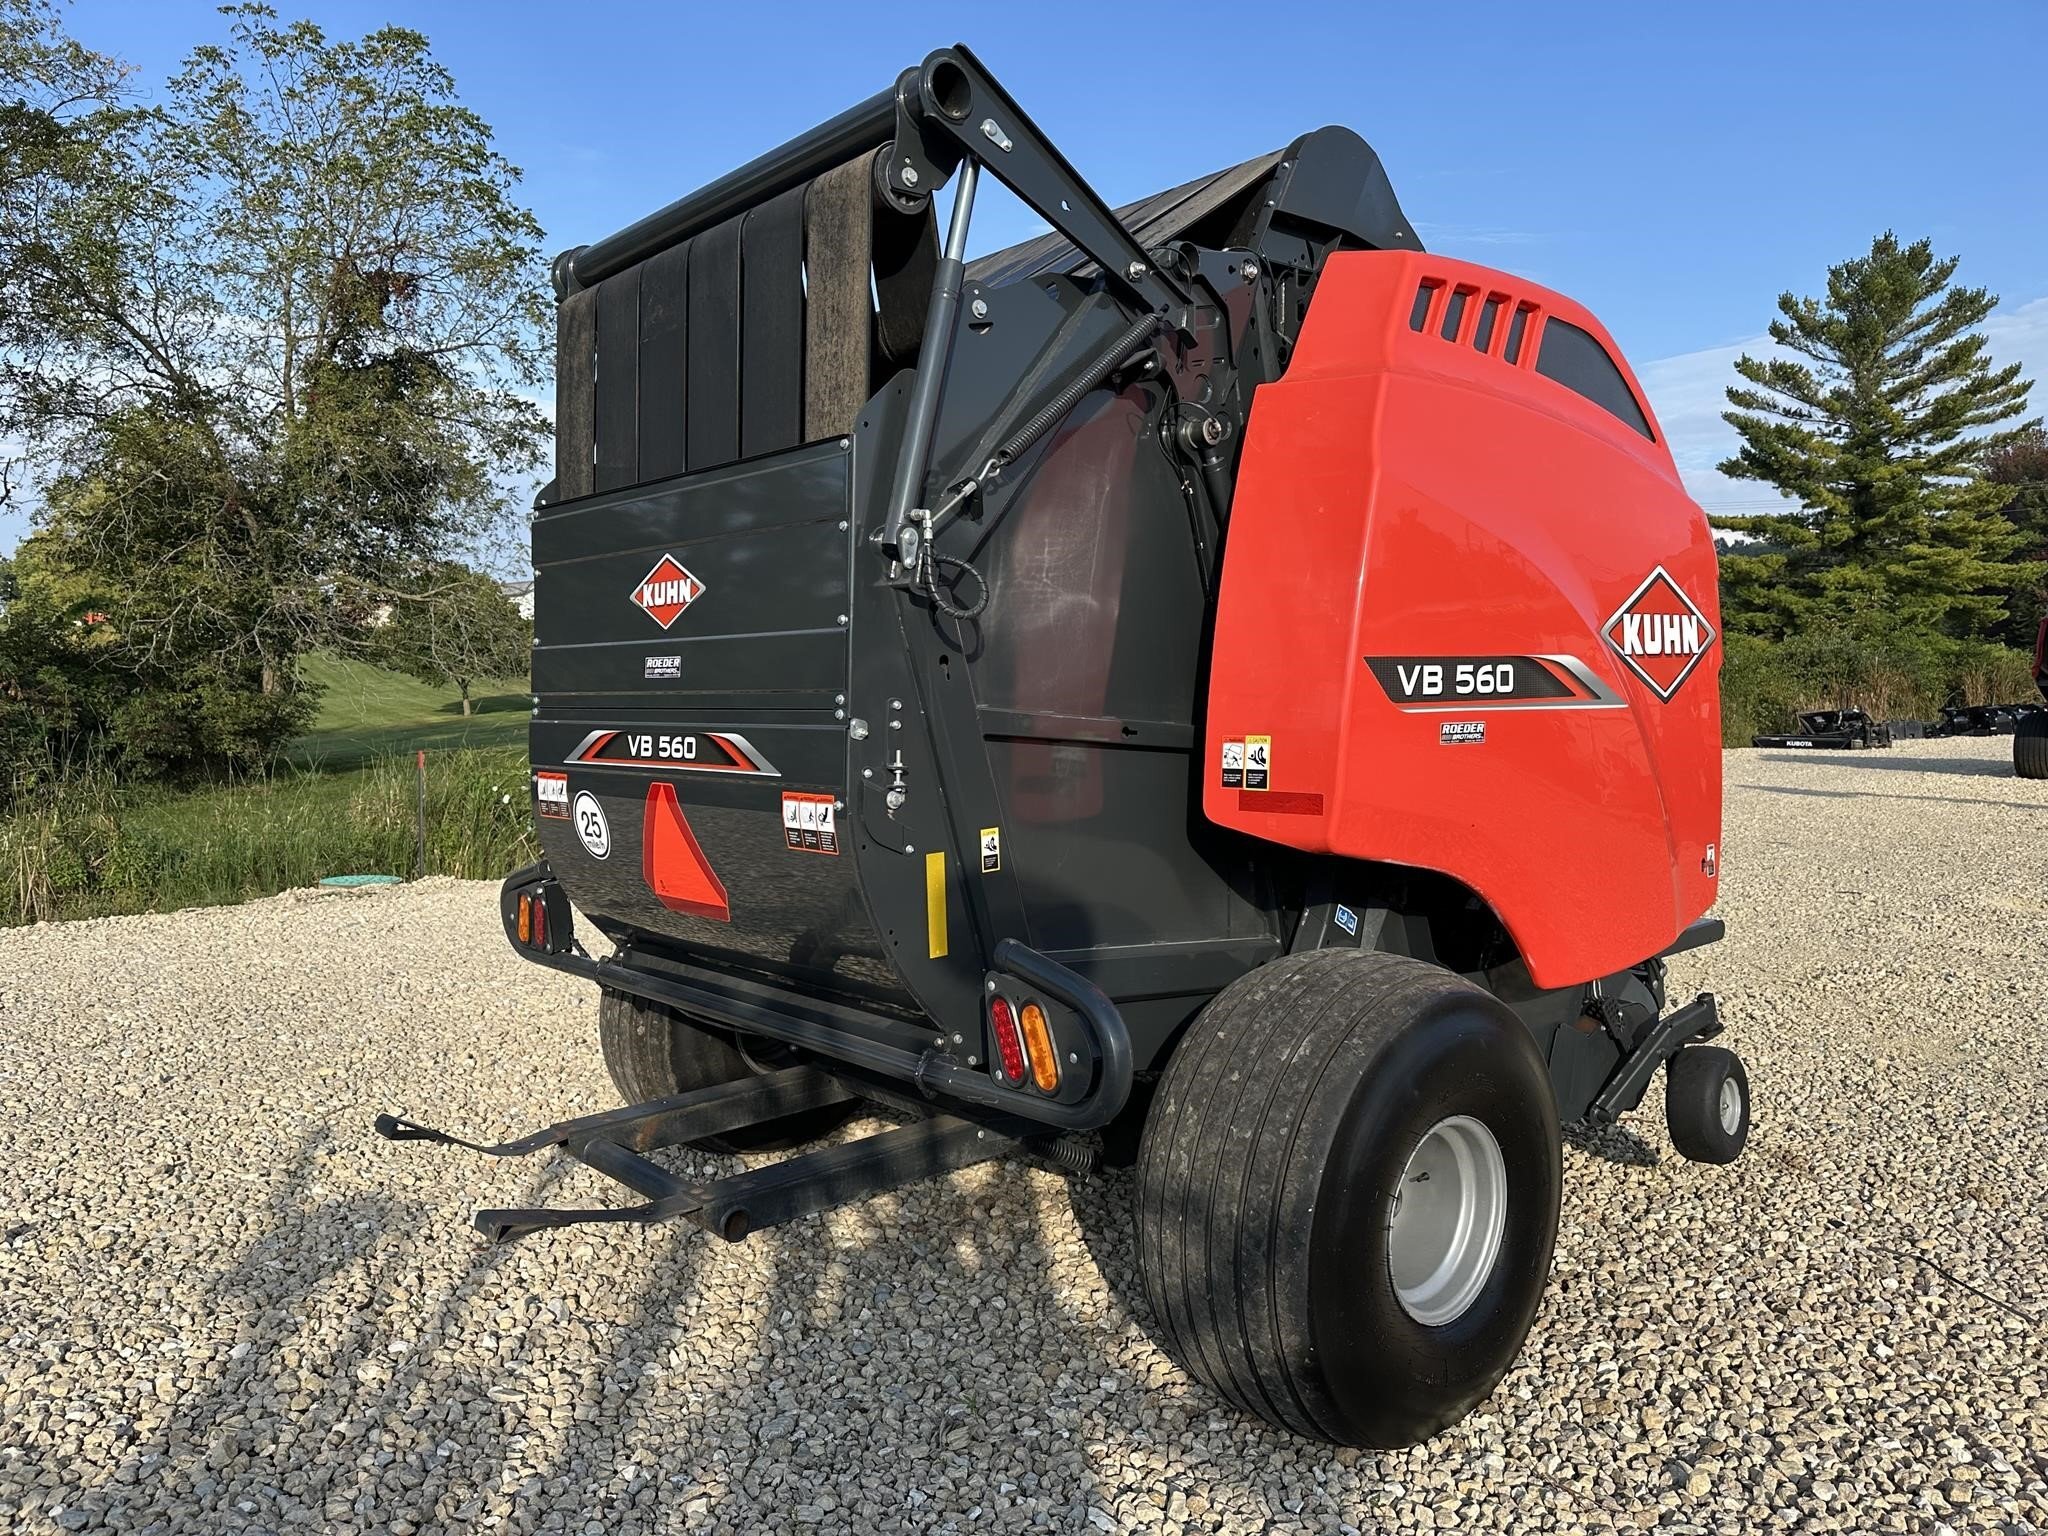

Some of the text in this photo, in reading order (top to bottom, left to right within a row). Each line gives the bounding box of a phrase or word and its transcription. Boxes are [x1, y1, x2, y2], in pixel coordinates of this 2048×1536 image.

[642, 578, 691, 607] KUHN
[1622, 613, 1699, 655] KUHN
[646, 659, 680, 668] ROEDER
[1396, 664, 1514, 696] VB 560
[1442, 723, 1485, 734] ROEDER
[627, 735, 697, 760] VB 560
[581, 810, 602, 839] 25
